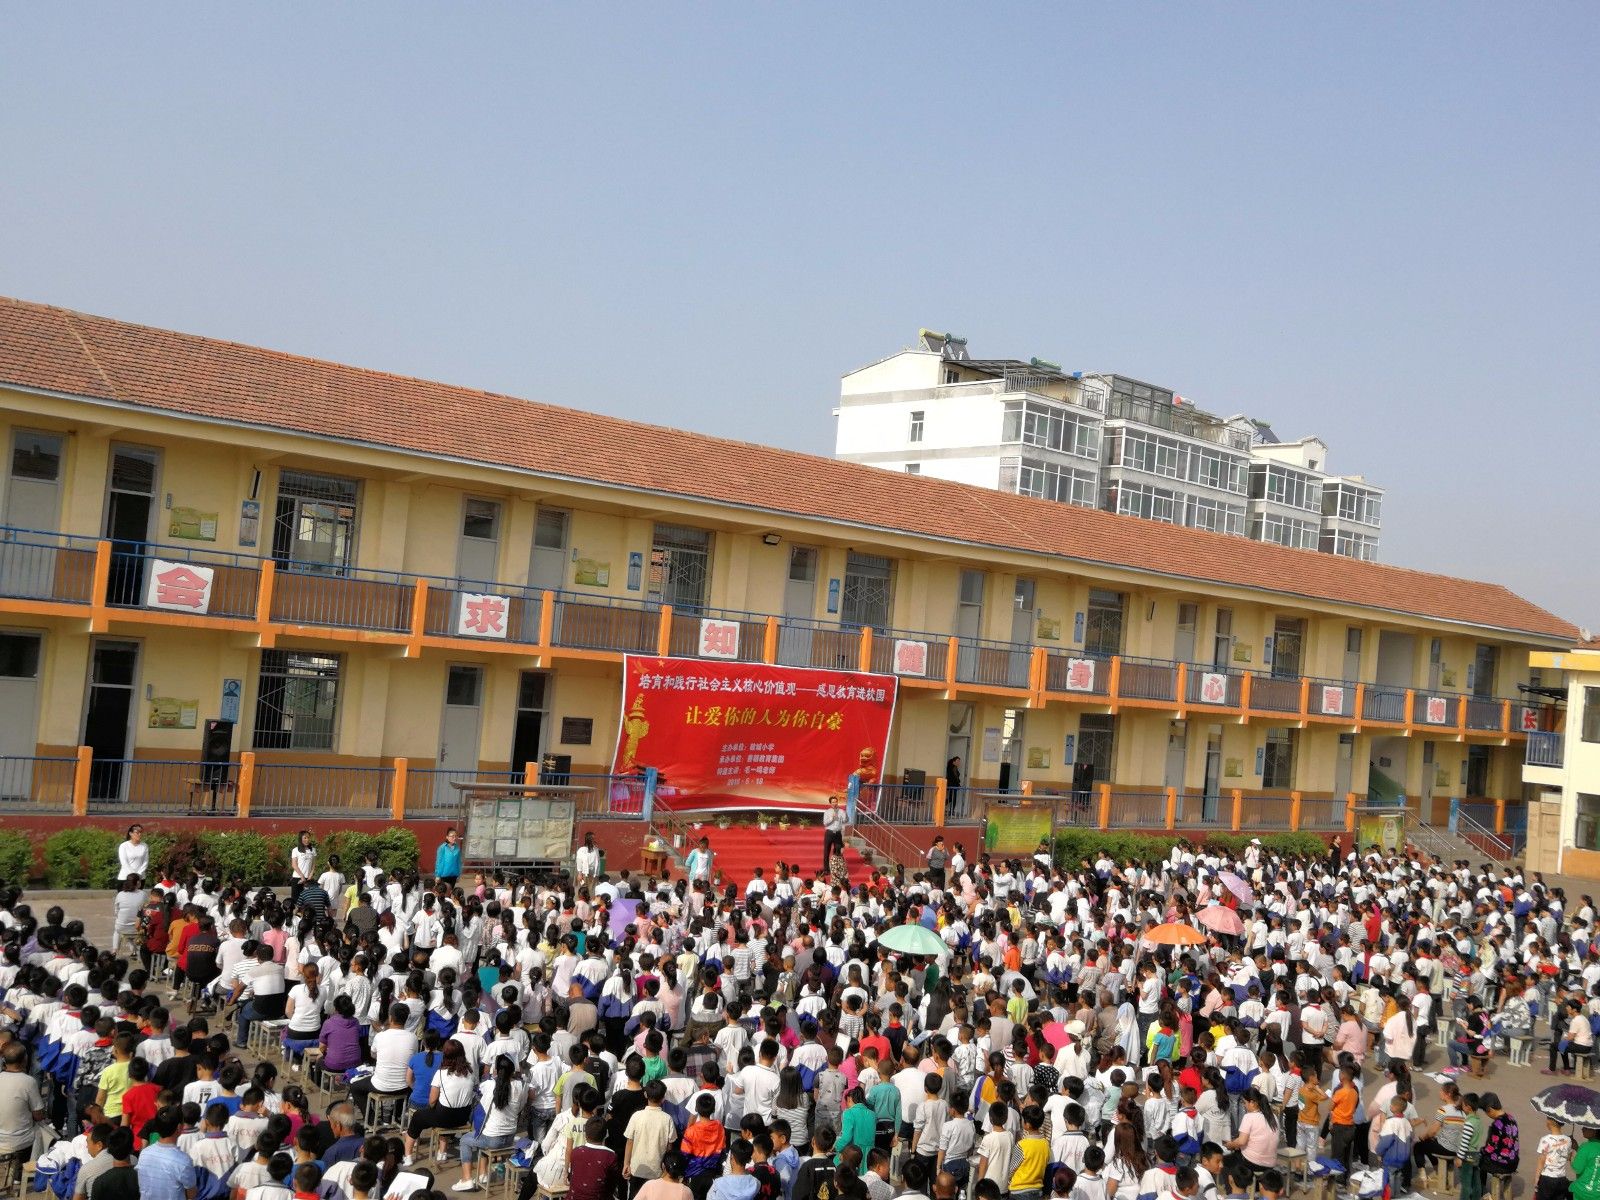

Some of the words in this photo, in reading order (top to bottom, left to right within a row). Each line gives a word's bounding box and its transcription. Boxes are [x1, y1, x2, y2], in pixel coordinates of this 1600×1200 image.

[156, 566, 208, 609] 会
[464, 598, 506, 633] 求
[704, 622, 738, 655] 知
[1204, 676, 1224, 700] 心
[684, 705, 844, 731] 让爱你的人为你自豪
[199, 1092, 212, 1104] 17
